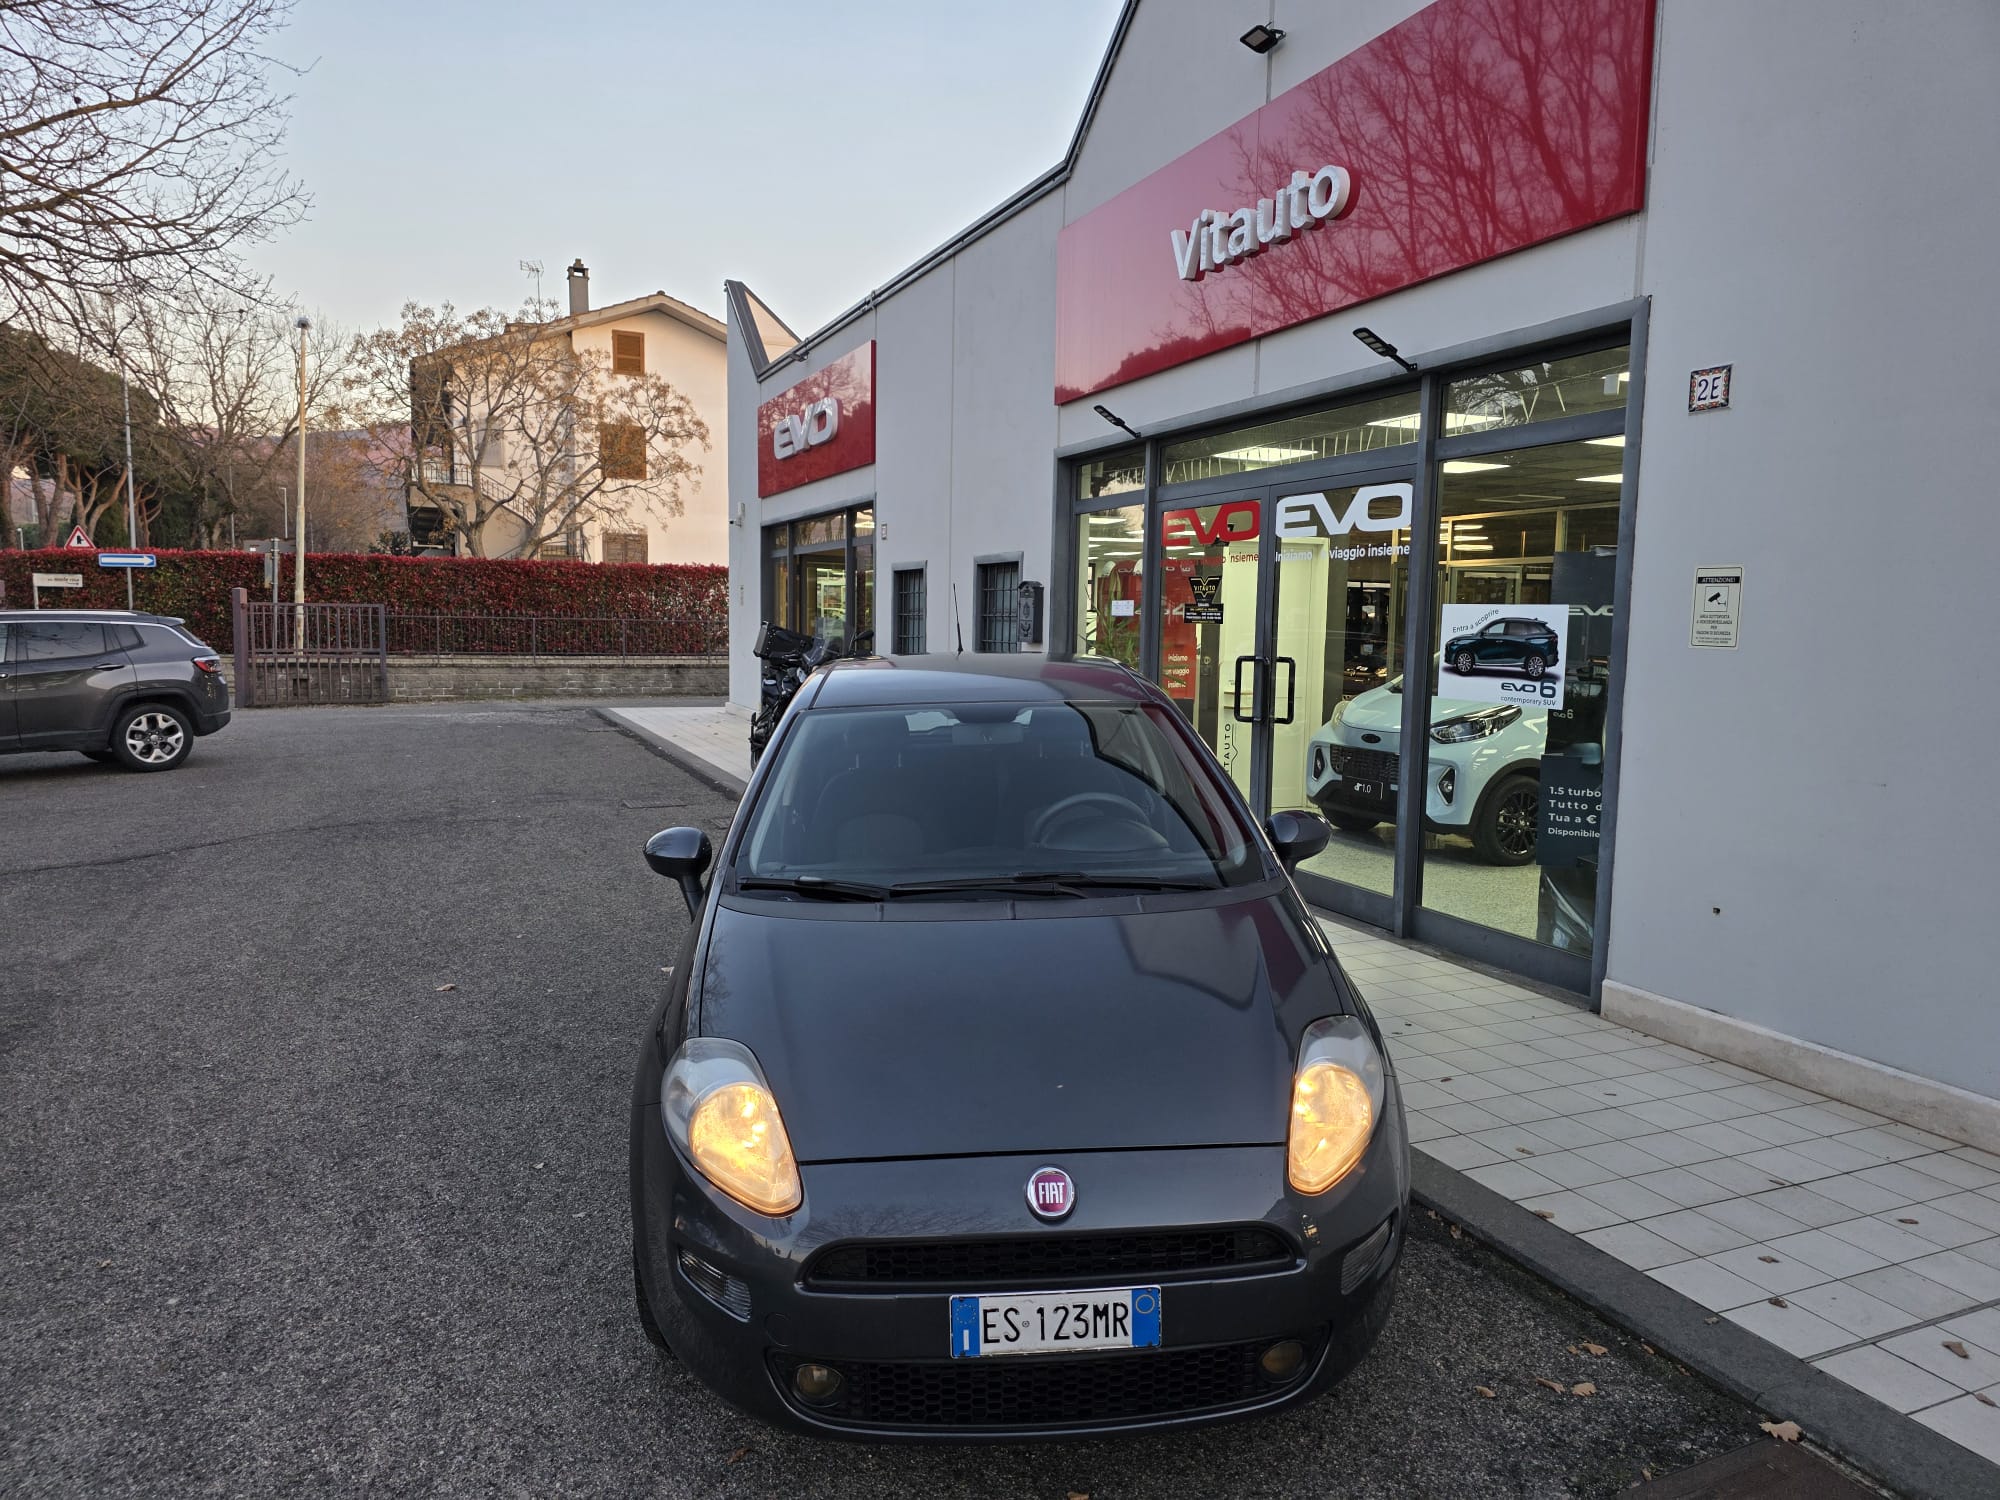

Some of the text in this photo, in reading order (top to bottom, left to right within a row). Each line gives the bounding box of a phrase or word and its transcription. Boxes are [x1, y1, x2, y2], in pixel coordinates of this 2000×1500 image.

[1170, 164, 1351, 281] Vitauto
[773, 396, 838, 460] EVO
[1275, 482, 1414, 538] EVO
[1161, 499, 1261, 548] EVO
[1329, 544, 1366, 561] viaggio
[1367, 542, 1411, 558] insieme
[1452, 625, 1469, 633] Entra
[1501, 679, 1557, 699] EVO 6
[1501, 695, 1542, 706] contemporary
[1223, 723, 1232, 774] TAUTO
[1548, 786, 1602, 798] 1.5 turbo
[1548, 799, 1588, 810] Tutto
[1548, 812, 1571, 822] Tua
[1586, 814, 1597, 824] €
[1037, 1181, 1065, 1204] FIAT
[982, 1306, 1021, 1344] ES
[1036, 1301, 1129, 1341] 123MR
